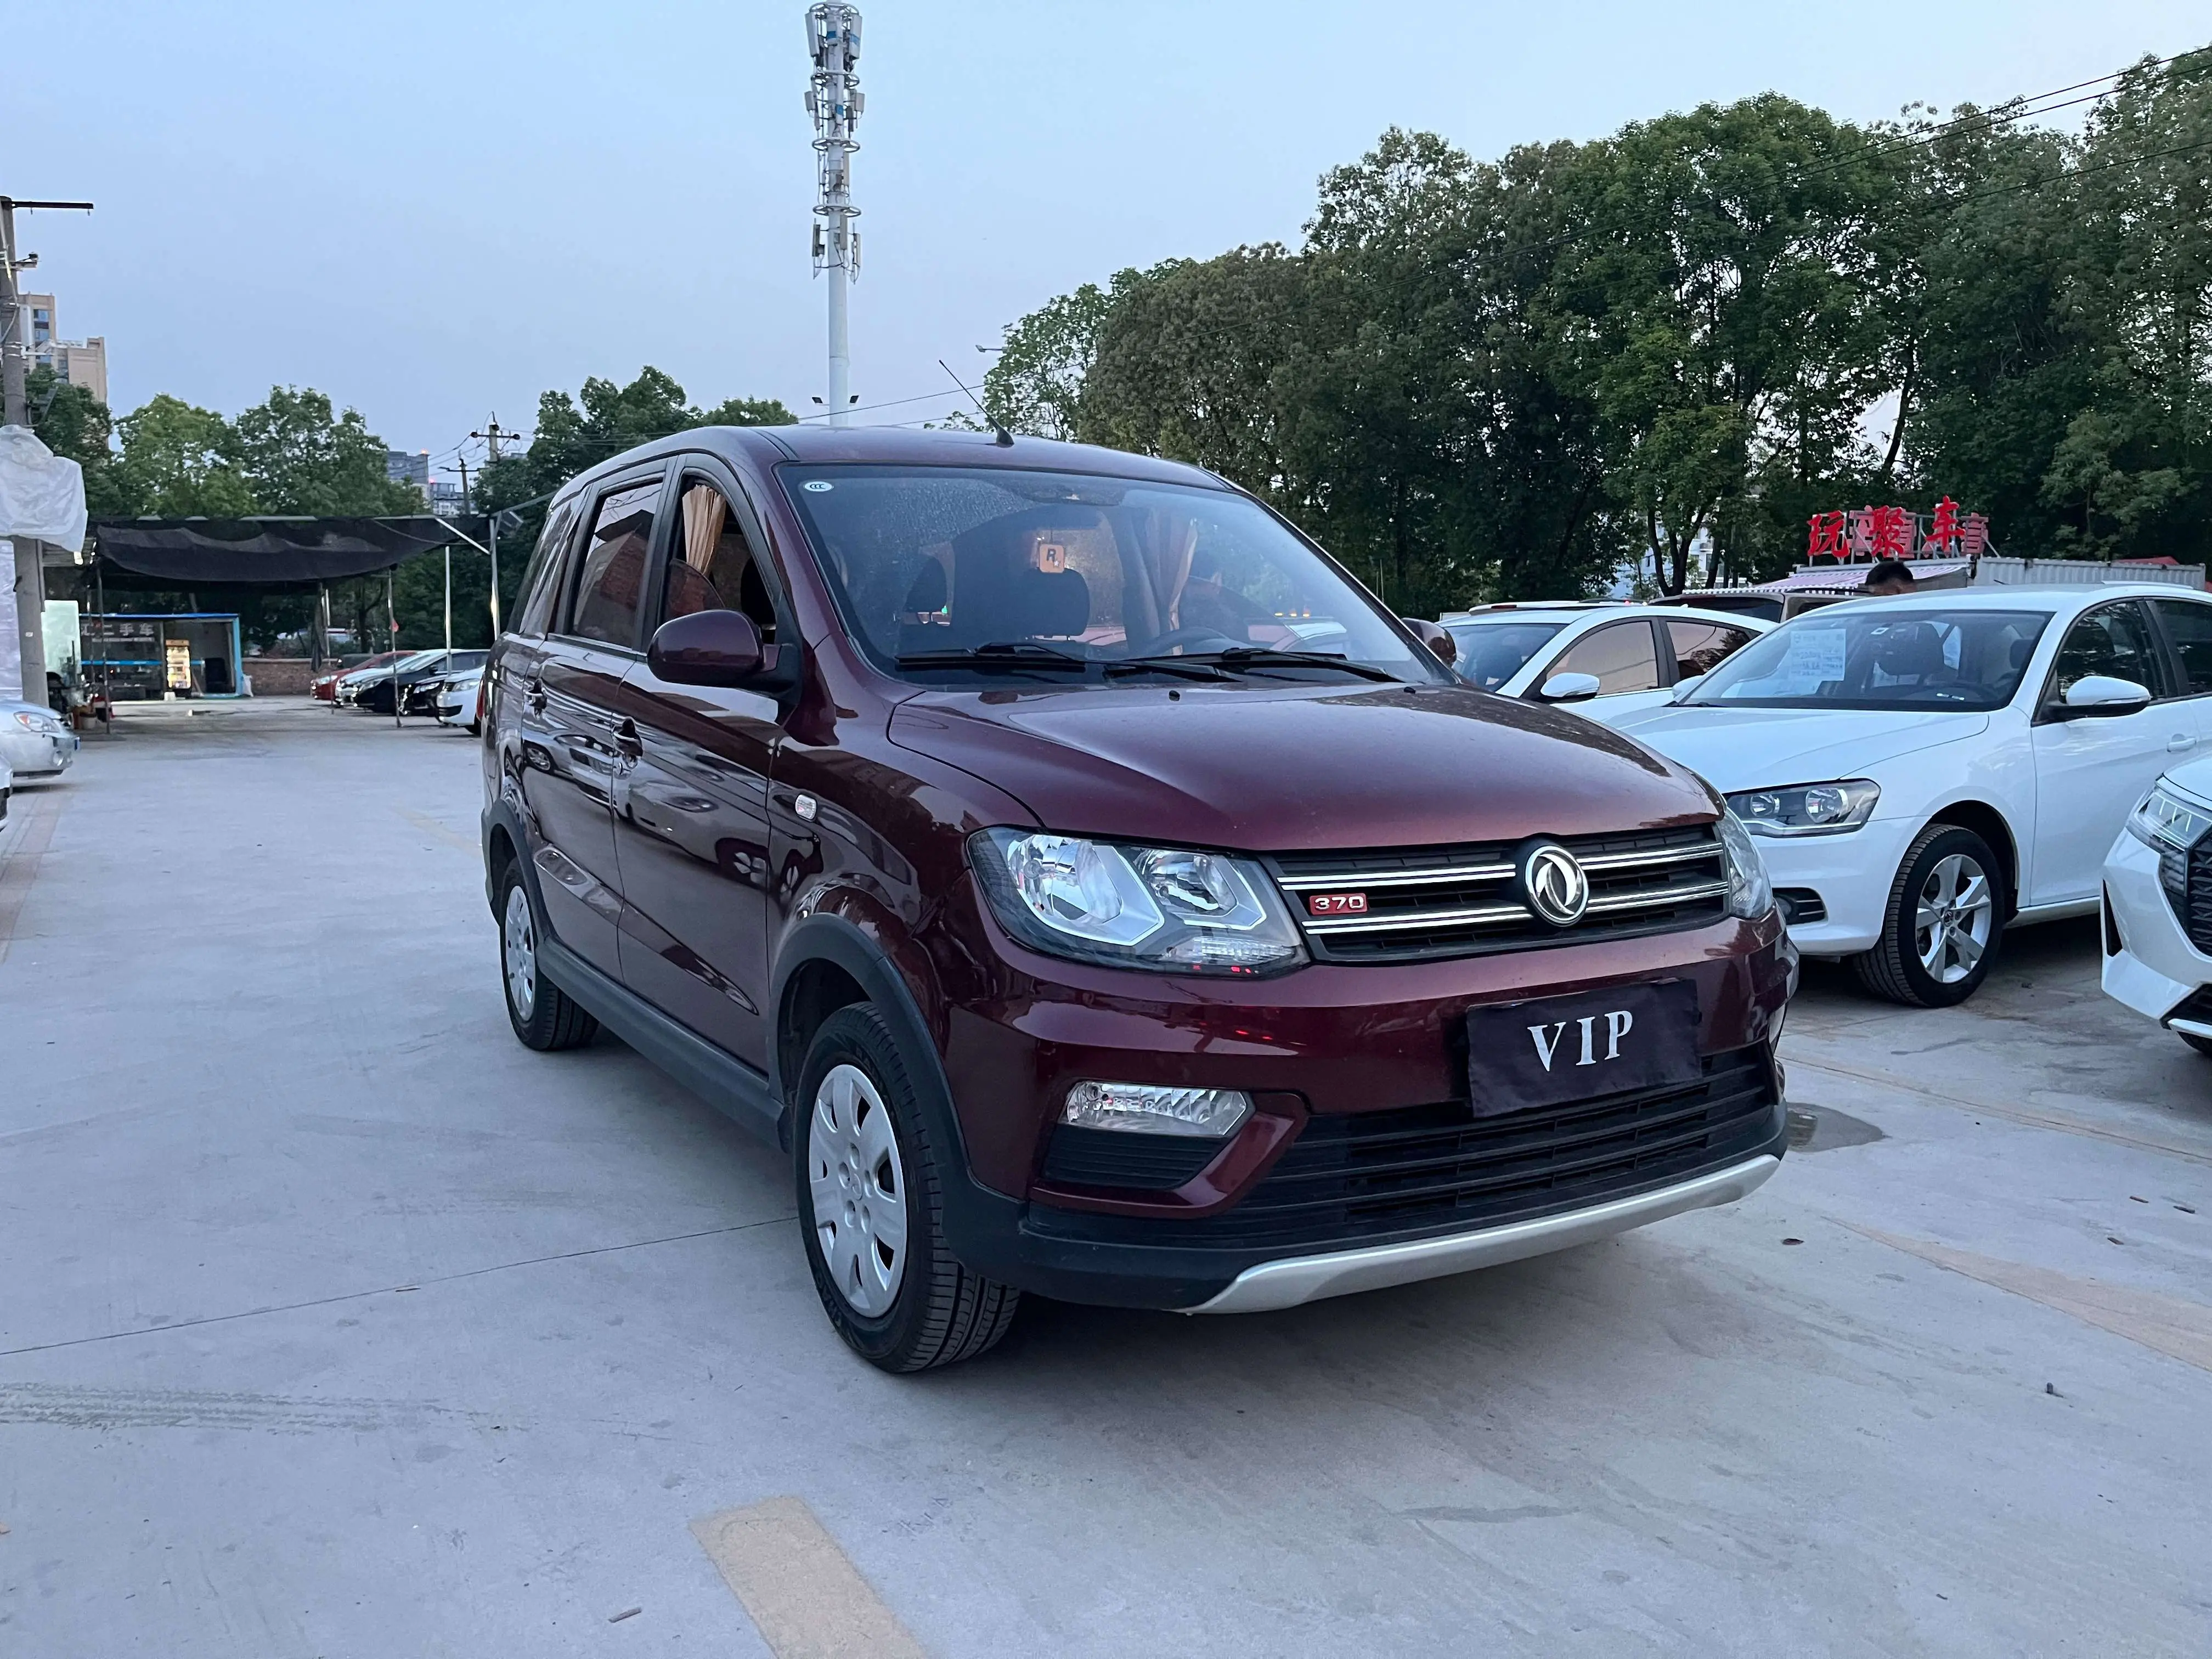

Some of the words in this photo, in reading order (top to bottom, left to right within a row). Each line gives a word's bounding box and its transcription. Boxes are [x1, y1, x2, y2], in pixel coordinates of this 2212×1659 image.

[1046, 549, 1056, 564] R
[1315, 896, 1364, 910] 370
[1527, 1010, 1633, 1072] VIP
